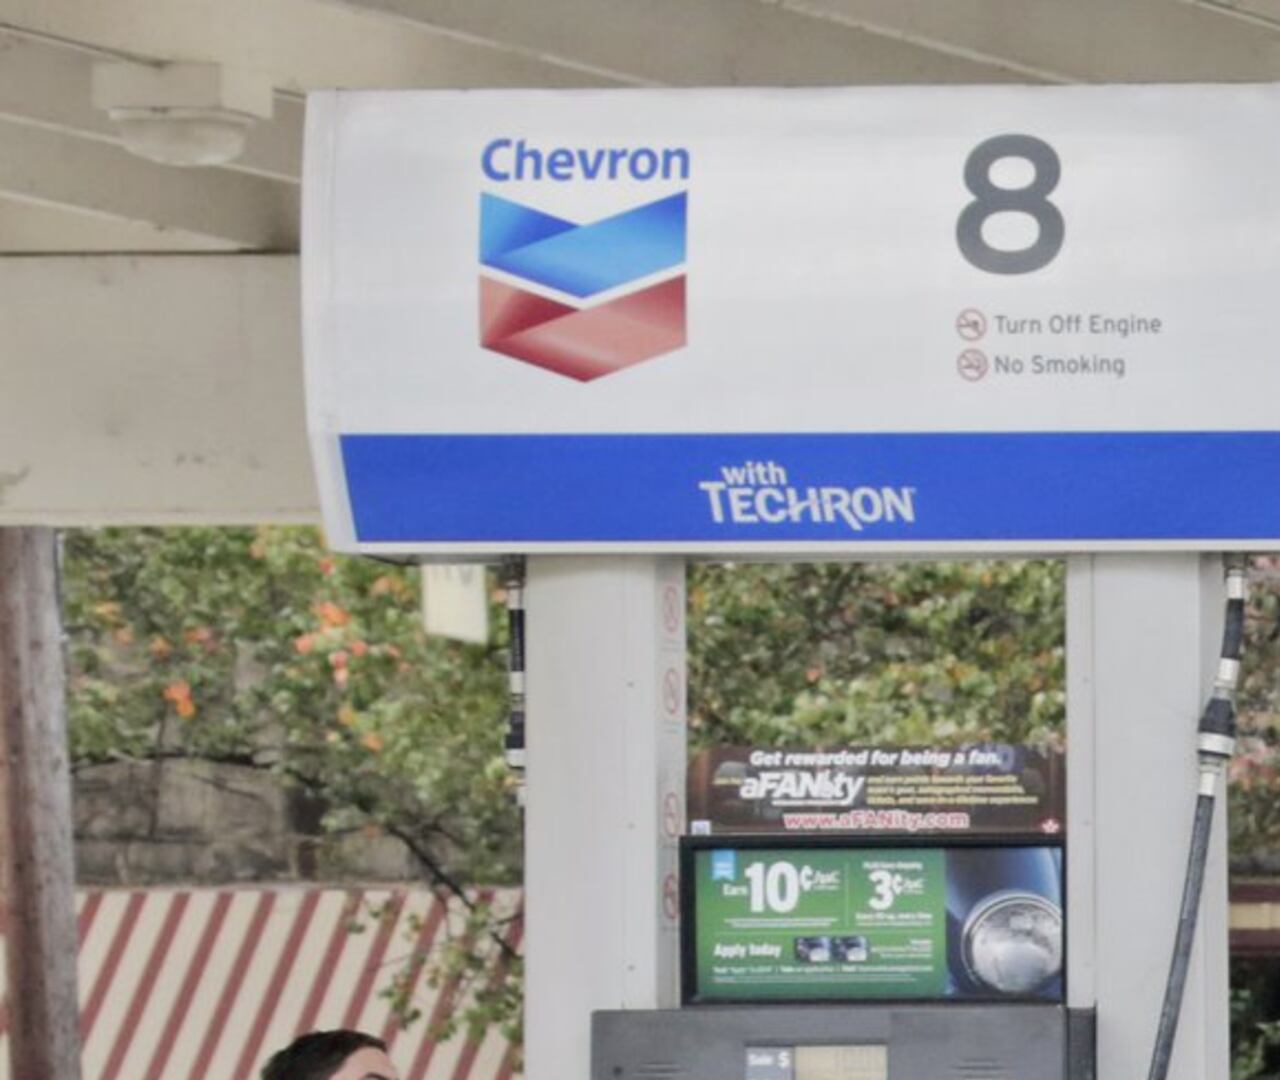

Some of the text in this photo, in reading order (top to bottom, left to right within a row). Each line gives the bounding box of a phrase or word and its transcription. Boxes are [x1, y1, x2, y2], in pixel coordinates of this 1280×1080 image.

[481, 138, 690, 181] Chevron
[955, 132, 1065, 275] 8
[994, 314, 1162, 337] Turn Off Engine
[994, 355, 1126, 377] No Smoking
[721, 461, 787, 485] with
[698, 481, 916, 531] TECHRON
[750, 750, 1002, 767] Get rewarded for being a fan.
[713, 943, 747, 959] Apply
